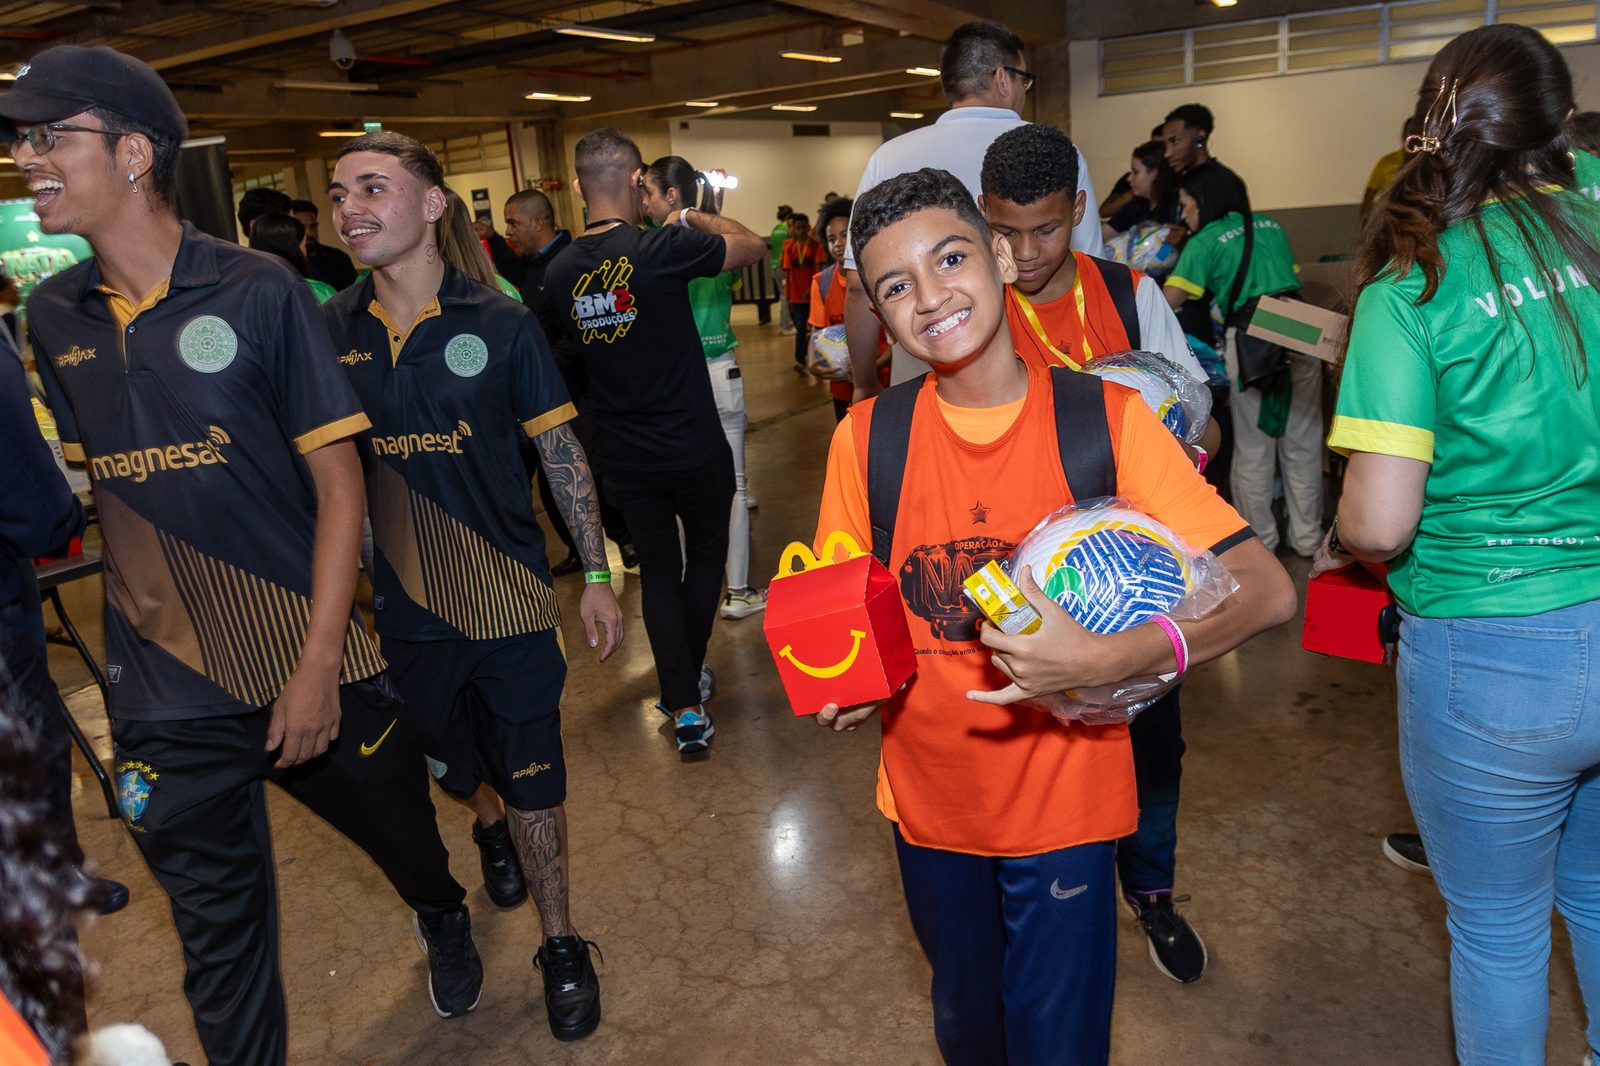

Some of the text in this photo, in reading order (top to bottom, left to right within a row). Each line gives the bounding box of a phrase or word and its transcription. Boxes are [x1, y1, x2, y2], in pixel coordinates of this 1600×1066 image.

[574, 289, 633, 318] BM2
[581, 311, 636, 329] PRODUÇÕES
[371, 430, 464, 460] magnesat
[91, 440, 229, 483] magnesat
